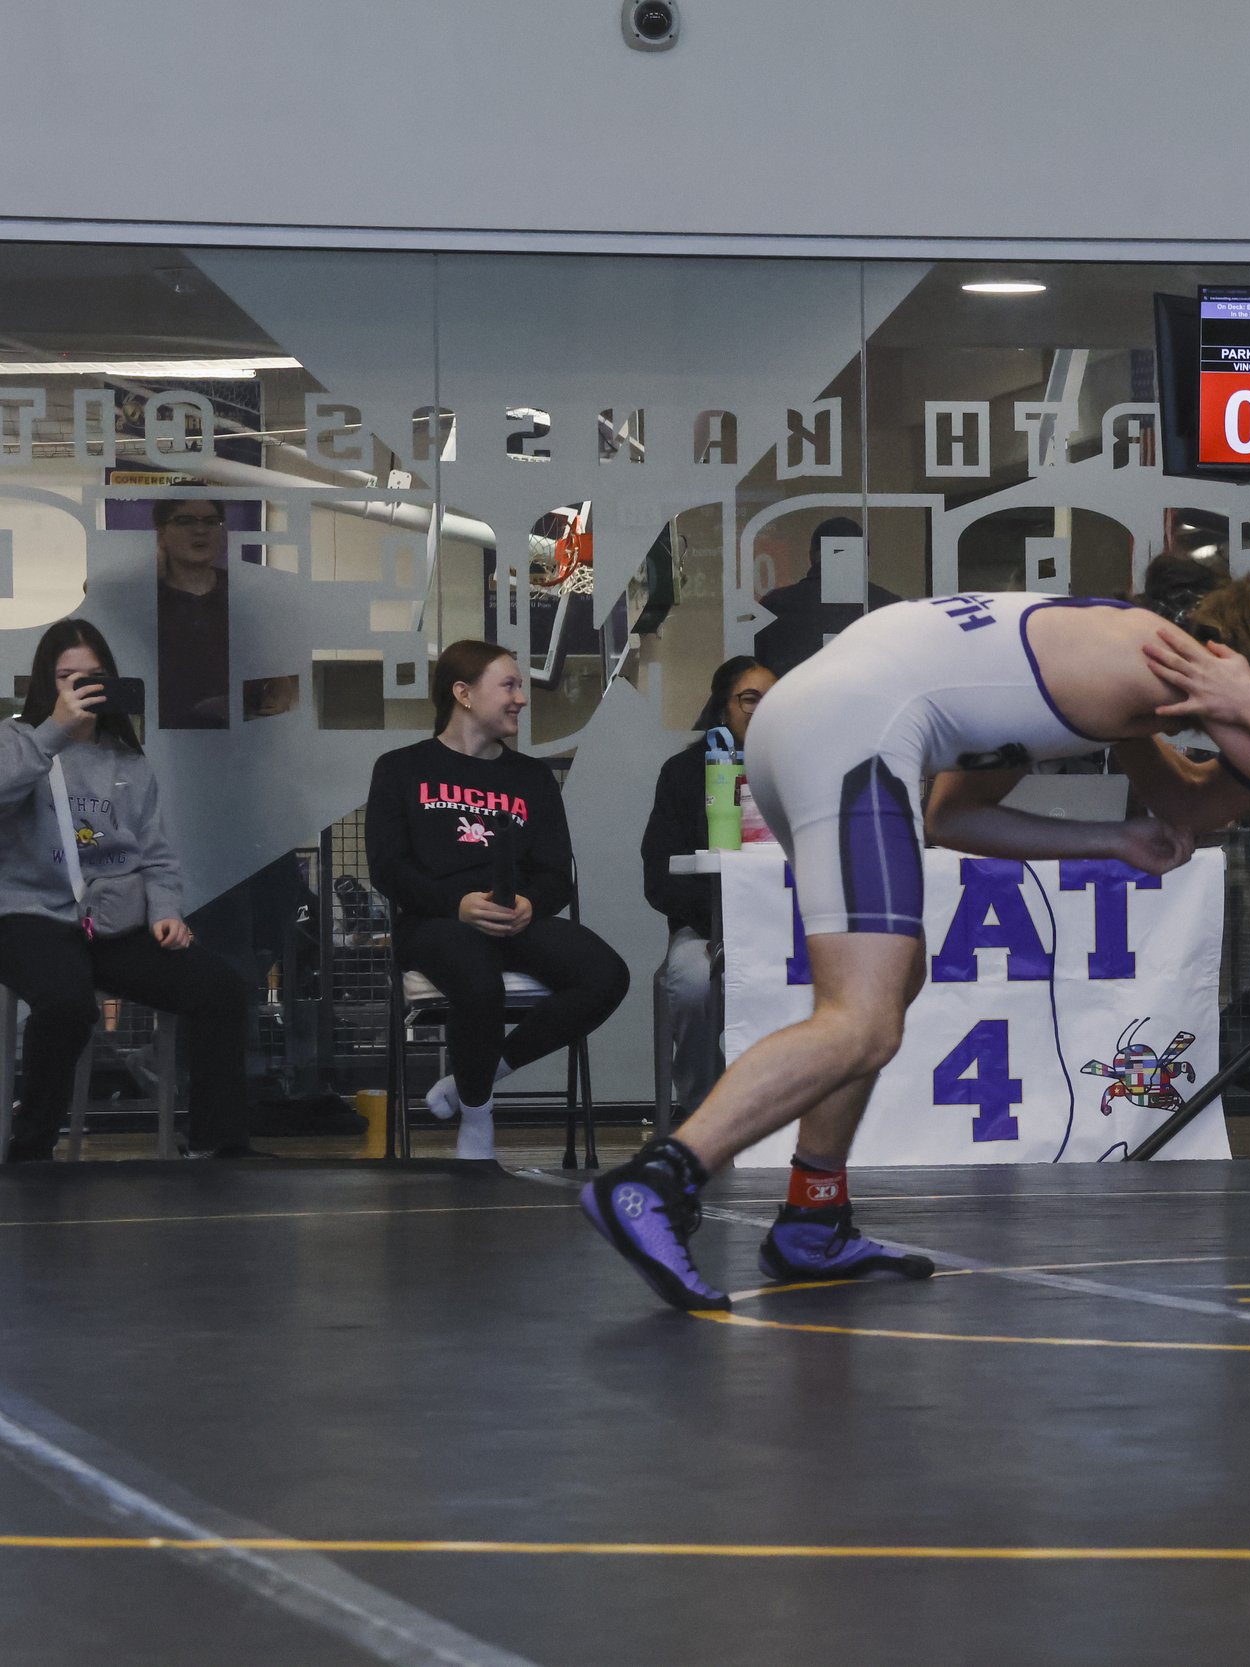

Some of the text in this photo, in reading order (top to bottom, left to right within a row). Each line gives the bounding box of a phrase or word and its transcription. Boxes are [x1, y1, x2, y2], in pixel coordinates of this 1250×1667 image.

[420, 782, 528, 821] LUCHA
[785, 858, 1162, 985] AT
[933, 1019, 1022, 1142] 4
